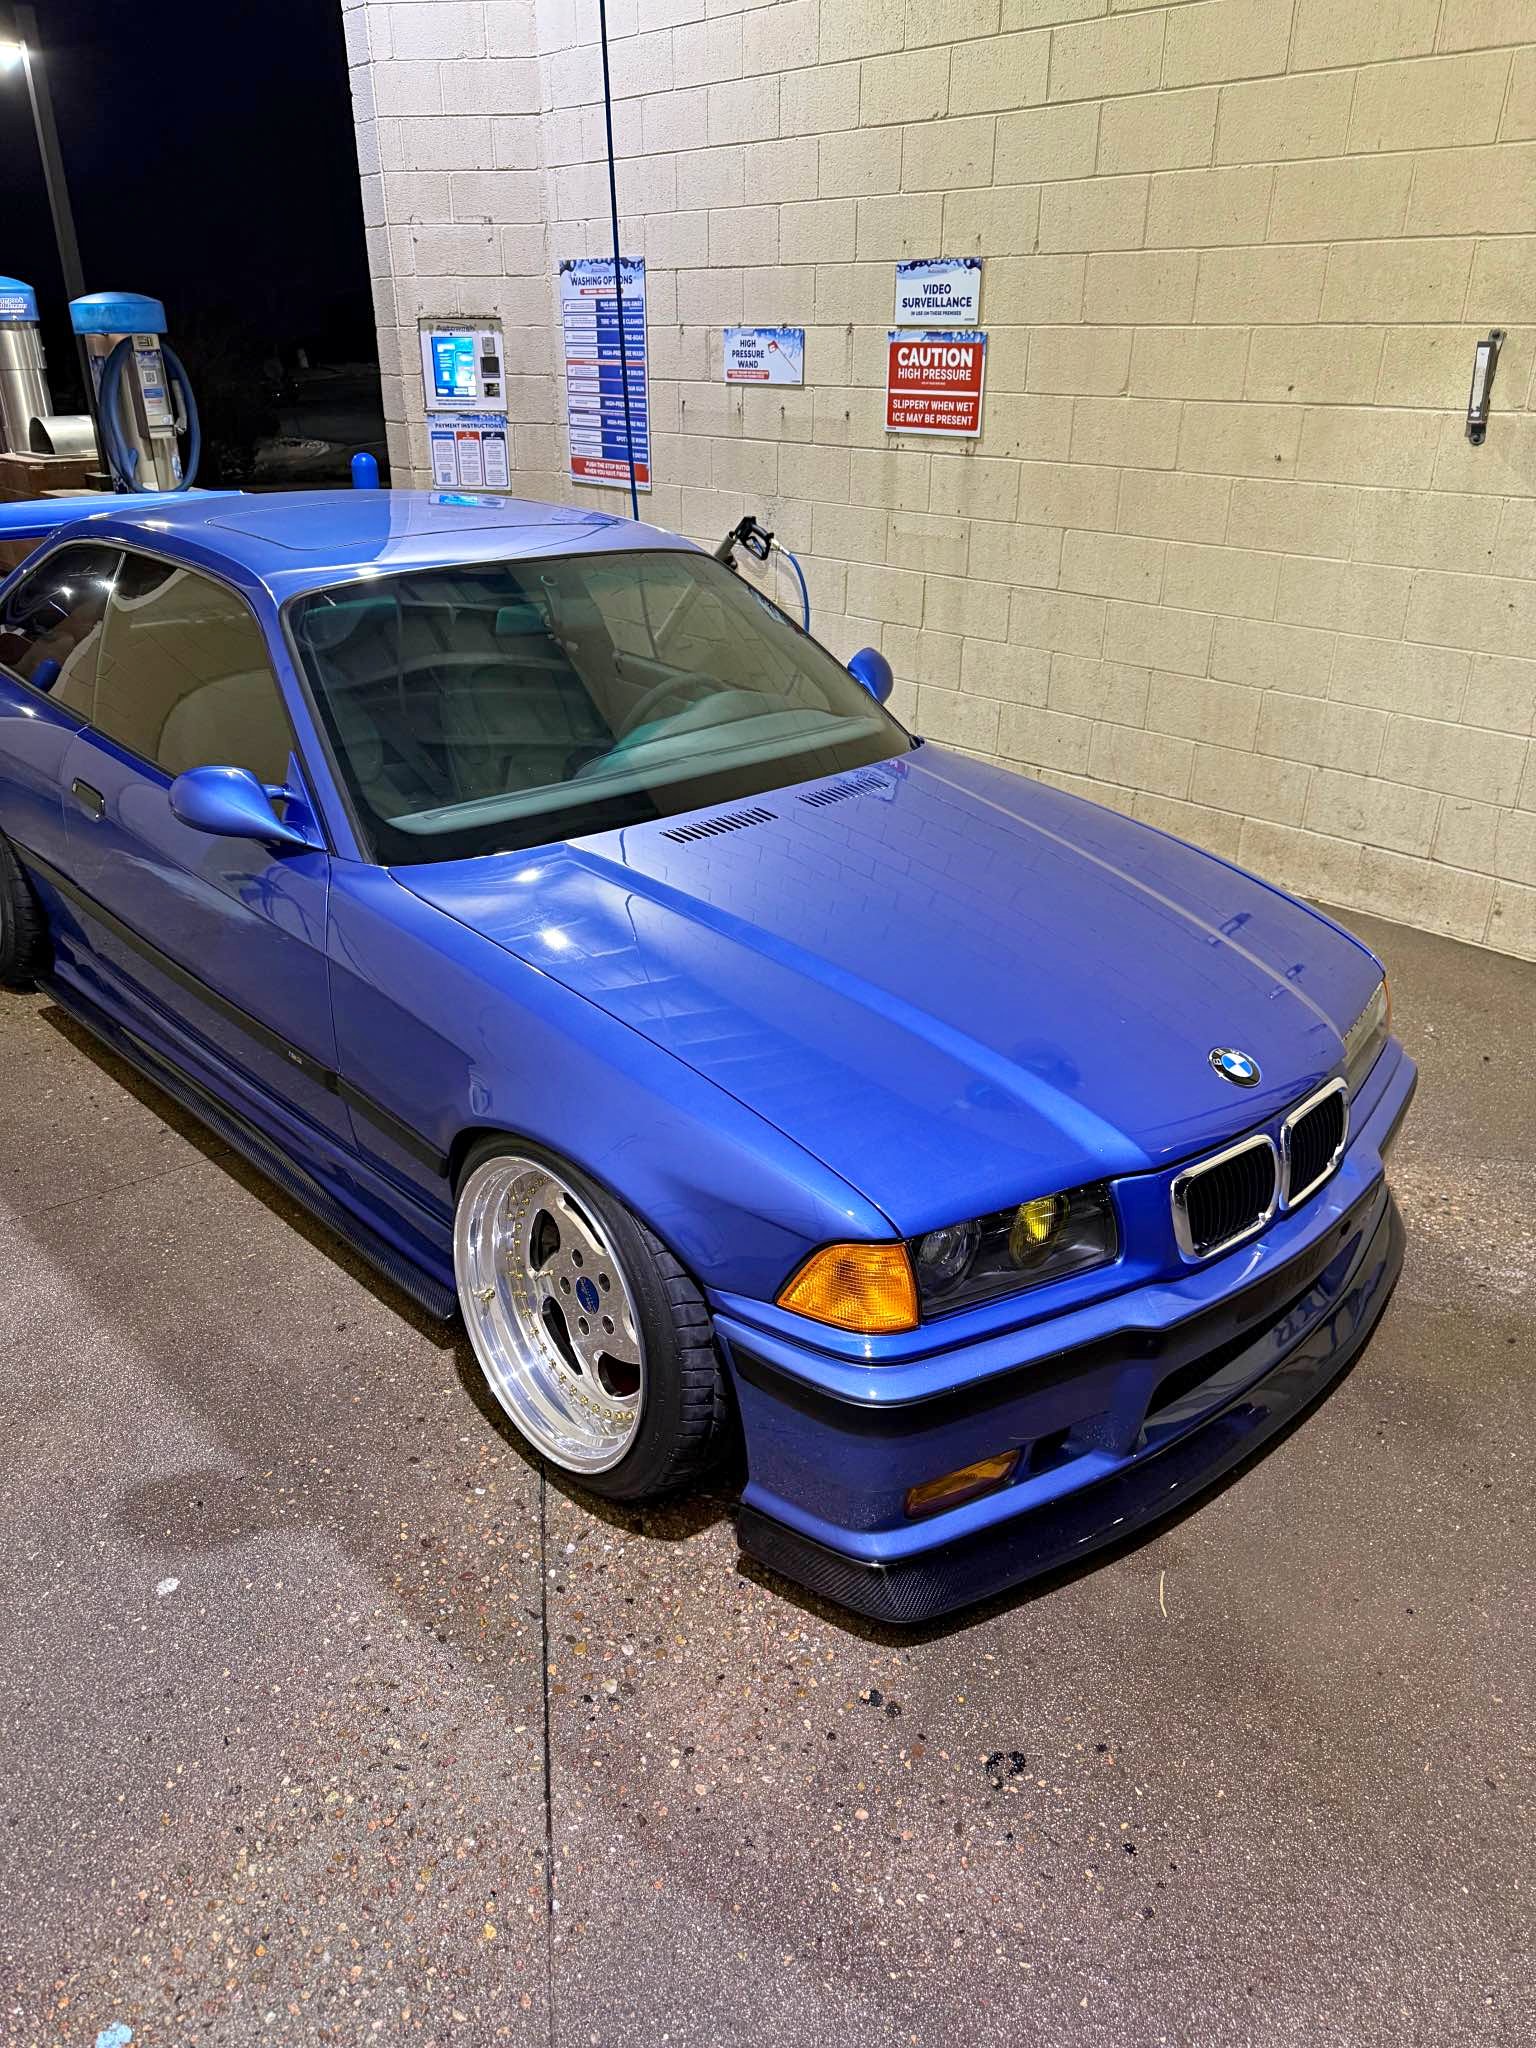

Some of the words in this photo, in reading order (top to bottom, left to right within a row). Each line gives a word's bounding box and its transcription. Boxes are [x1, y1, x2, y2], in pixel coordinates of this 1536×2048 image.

[571, 276, 601, 286] WASHING
[603, 275, 632, 285] OPTONS
[923, 284, 951, 294] VIDEO
[902, 297, 972, 308] SURVEILLANCE
[740, 339, 756, 347] HIGH
[732, 350, 764, 358] PRESSURE
[898, 348, 973, 367] CAUTION
[738, 360, 758, 368] WAND
[898, 368, 920, 379] HIGH
[923, 369, 972, 380] PRESSURE
[893, 399, 930, 410] SLIPPERY
[931, 401, 955, 411] WHEN
[956, 402, 974, 412] WET
[893, 412, 904, 422] ICE
[906, 413, 923, 423] MAY
[925, 414, 935, 424] BE
[936, 415, 973, 425] PRESENT
